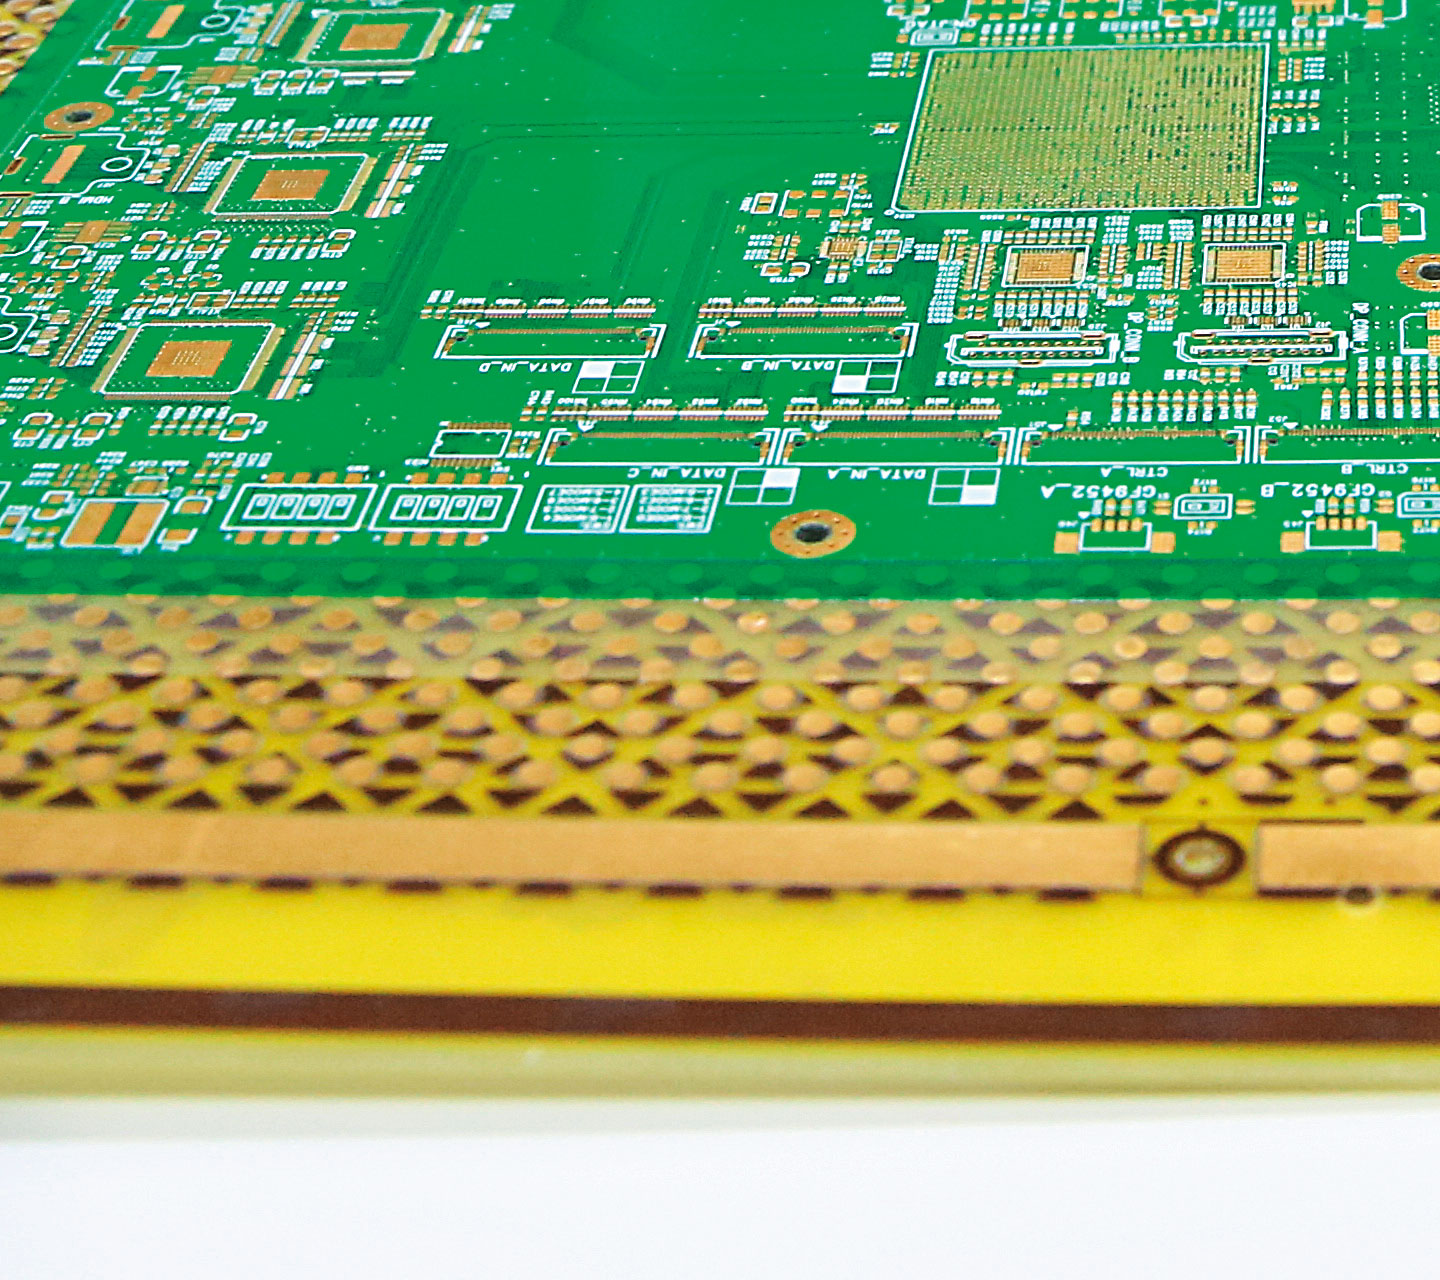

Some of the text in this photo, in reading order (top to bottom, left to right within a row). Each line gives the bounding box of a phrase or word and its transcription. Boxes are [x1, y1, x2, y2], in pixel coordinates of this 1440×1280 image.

[60, 196, 114, 204] HDMI_B
[478, 362, 573, 373] DATA_IN_D
[741, 360, 835, 371] DATA_IN_B
[627, 466, 725, 478] DATA_IN_C
[828, 468, 926, 480] DATA_IN_A
[1100, 466, 1168, 477] CTRL_A
[1341, 463, 1408, 474] CTRL_B
[1040, 483, 1156, 499] GF9452_A
[1260, 482, 1375, 497] GF9452_B
